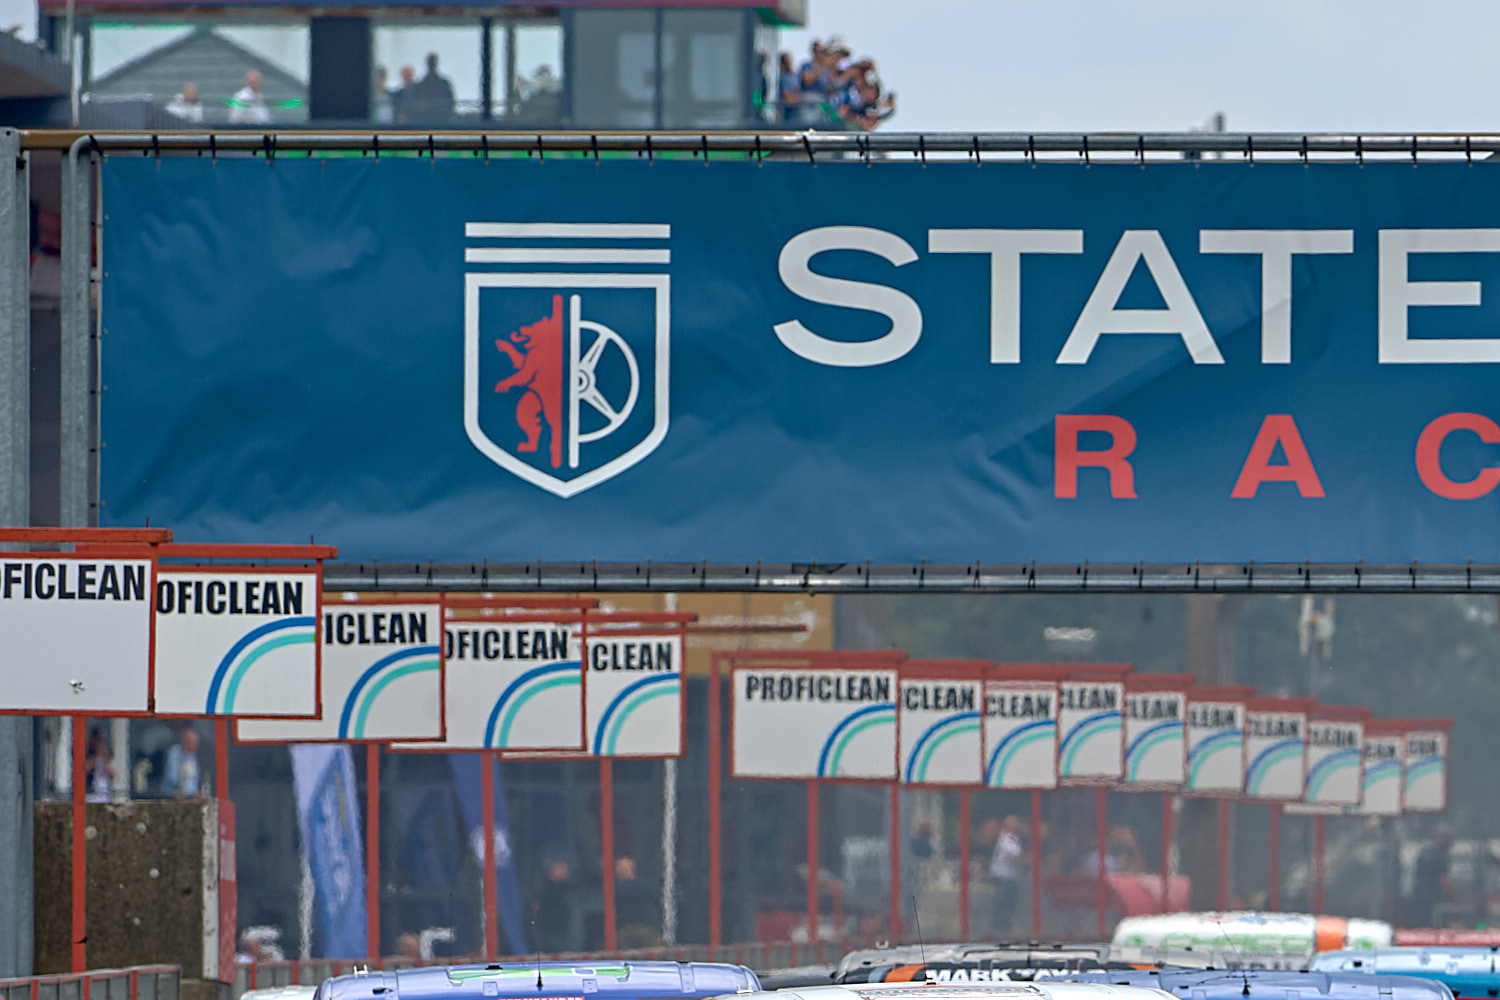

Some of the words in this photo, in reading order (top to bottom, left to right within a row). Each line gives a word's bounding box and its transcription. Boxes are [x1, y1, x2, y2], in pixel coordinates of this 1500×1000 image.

[0, 563, 146, 601] FICLEAN
[157, 580, 303, 615] OFICLEAN
[745, 674, 890, 702] PROFICLEAN
